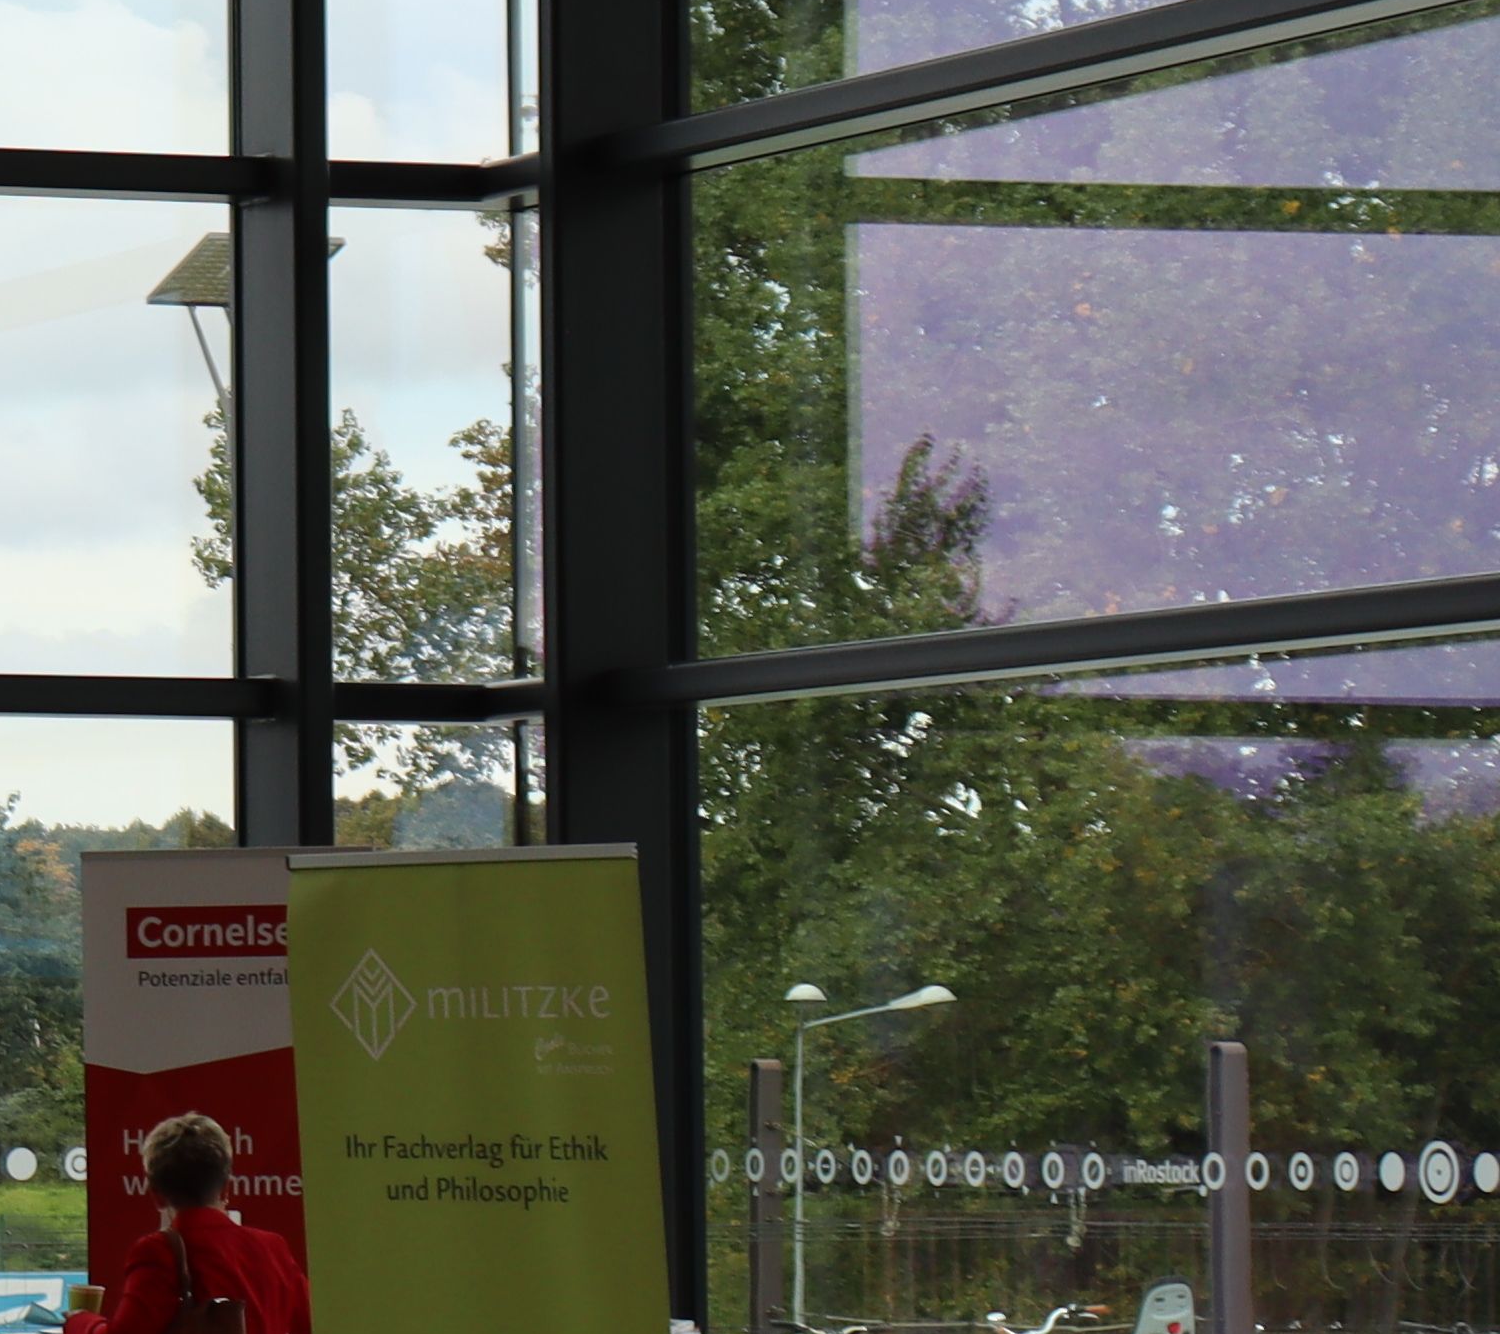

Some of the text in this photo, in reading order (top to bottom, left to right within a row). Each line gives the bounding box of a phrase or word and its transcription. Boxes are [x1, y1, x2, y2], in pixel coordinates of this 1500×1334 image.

[138, 968, 288, 987] Potenziale entfal
[346, 1134, 608, 1168] Ihr Fachverlag für Ethik
[1123, 1158, 1201, 1184] inRostock
[387, 1175, 568, 1211] und Philosophie
